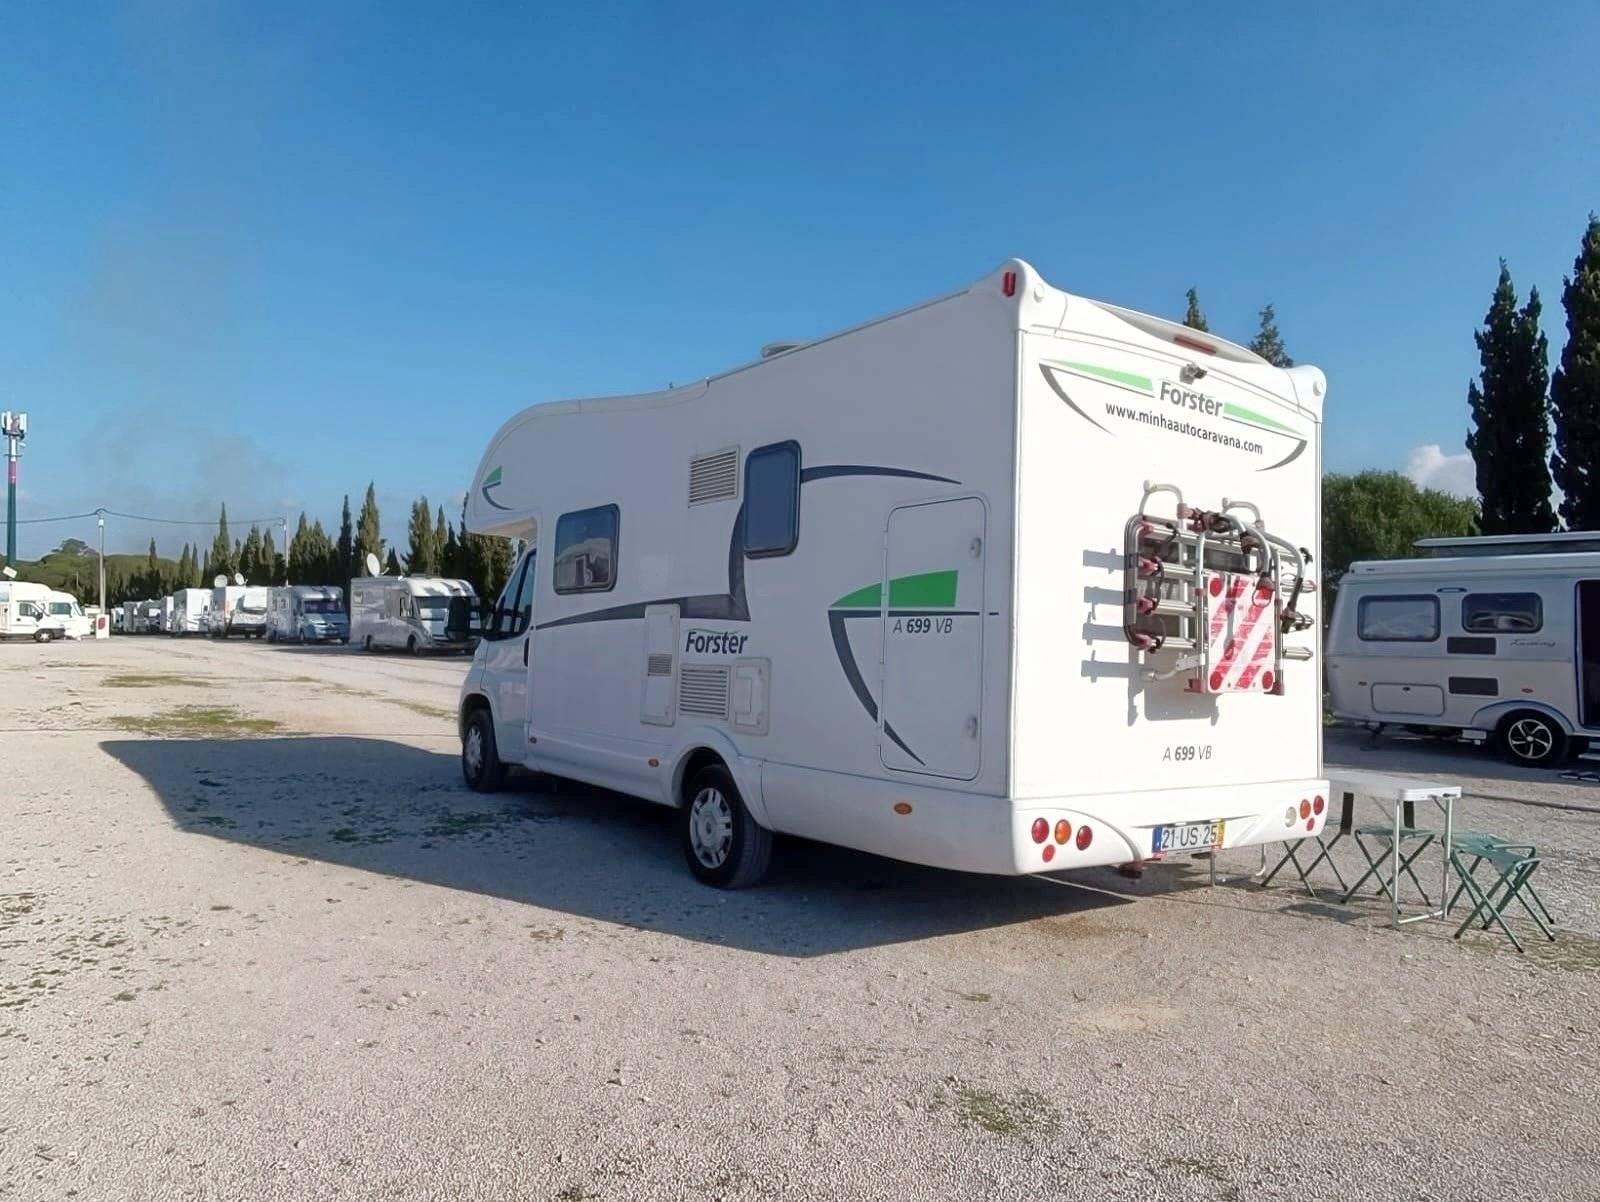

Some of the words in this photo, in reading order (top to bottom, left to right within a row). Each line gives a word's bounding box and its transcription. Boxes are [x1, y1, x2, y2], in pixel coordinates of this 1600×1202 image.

[1159, 381, 1222, 416] Forster
[1105, 401, 1263, 455] www.minhaautocaravana.com
[893, 619, 903, 634] A
[906, 618, 931, 634] 699
[935, 618, 953, 634] VB
[686, 631, 748, 654] Forster
[1163, 747, 1171, 761] A
[1174, 746, 1195, 760] 699
[1198, 745, 1212, 760] VB
